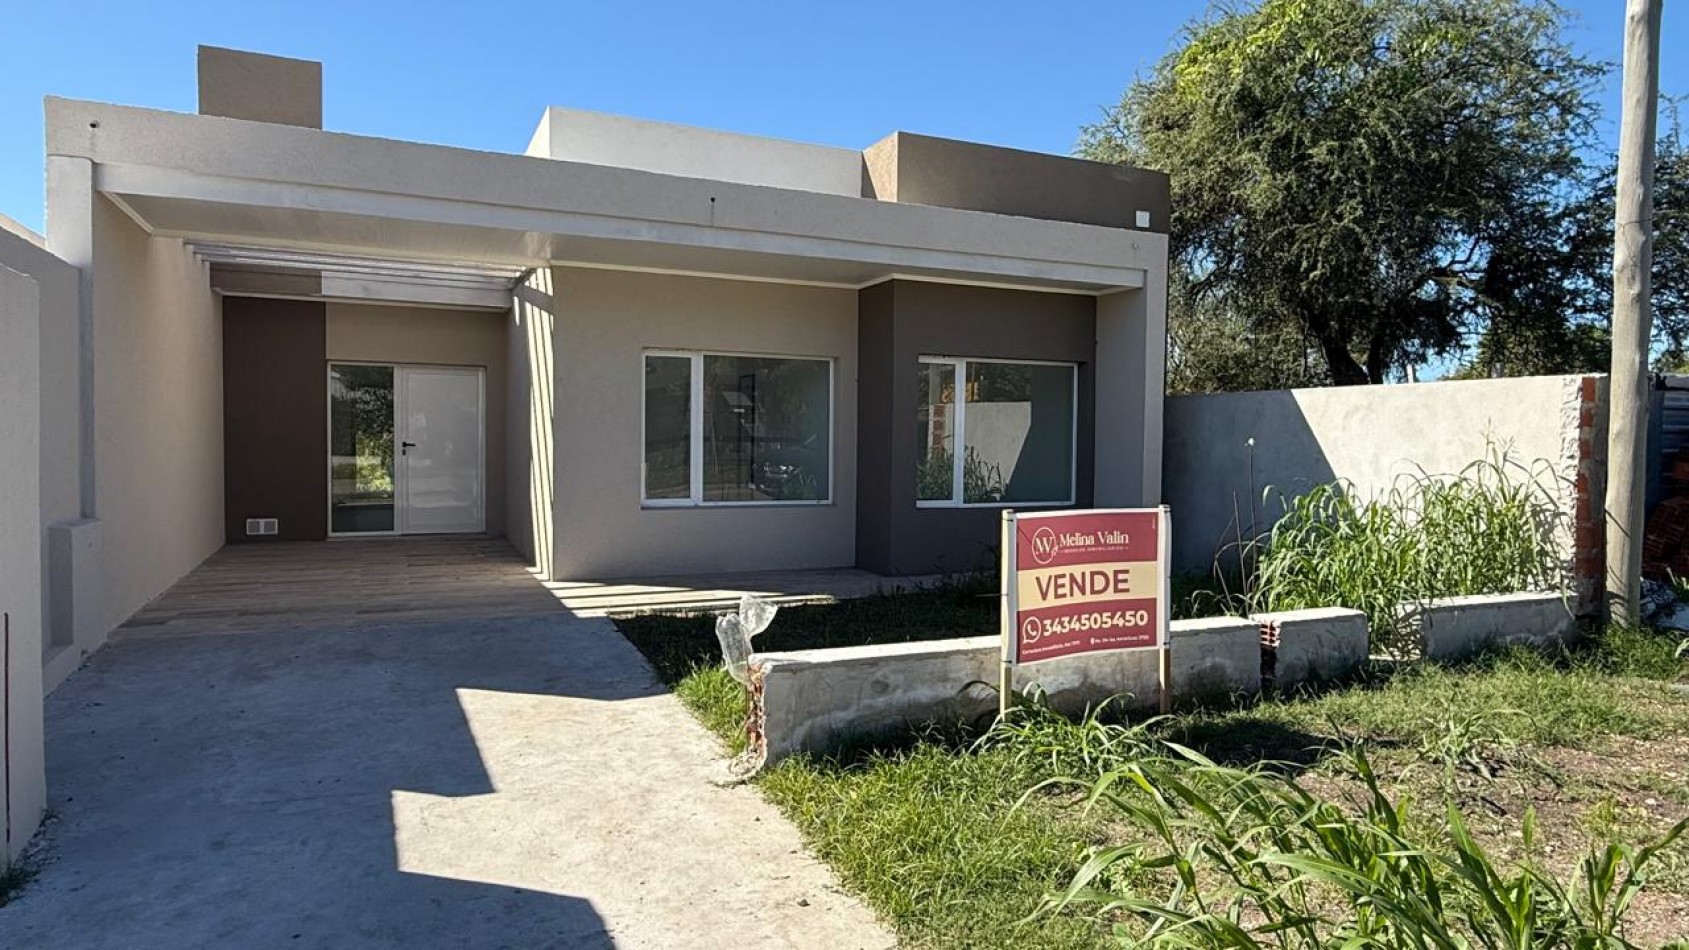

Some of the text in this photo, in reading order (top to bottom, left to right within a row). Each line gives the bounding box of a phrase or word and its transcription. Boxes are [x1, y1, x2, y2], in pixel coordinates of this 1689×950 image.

[1060, 531, 1129, 547] Melina Valin
[1035, 569, 1130, 601] VENDE
[1043, 610, 1149, 637] 3434505450
